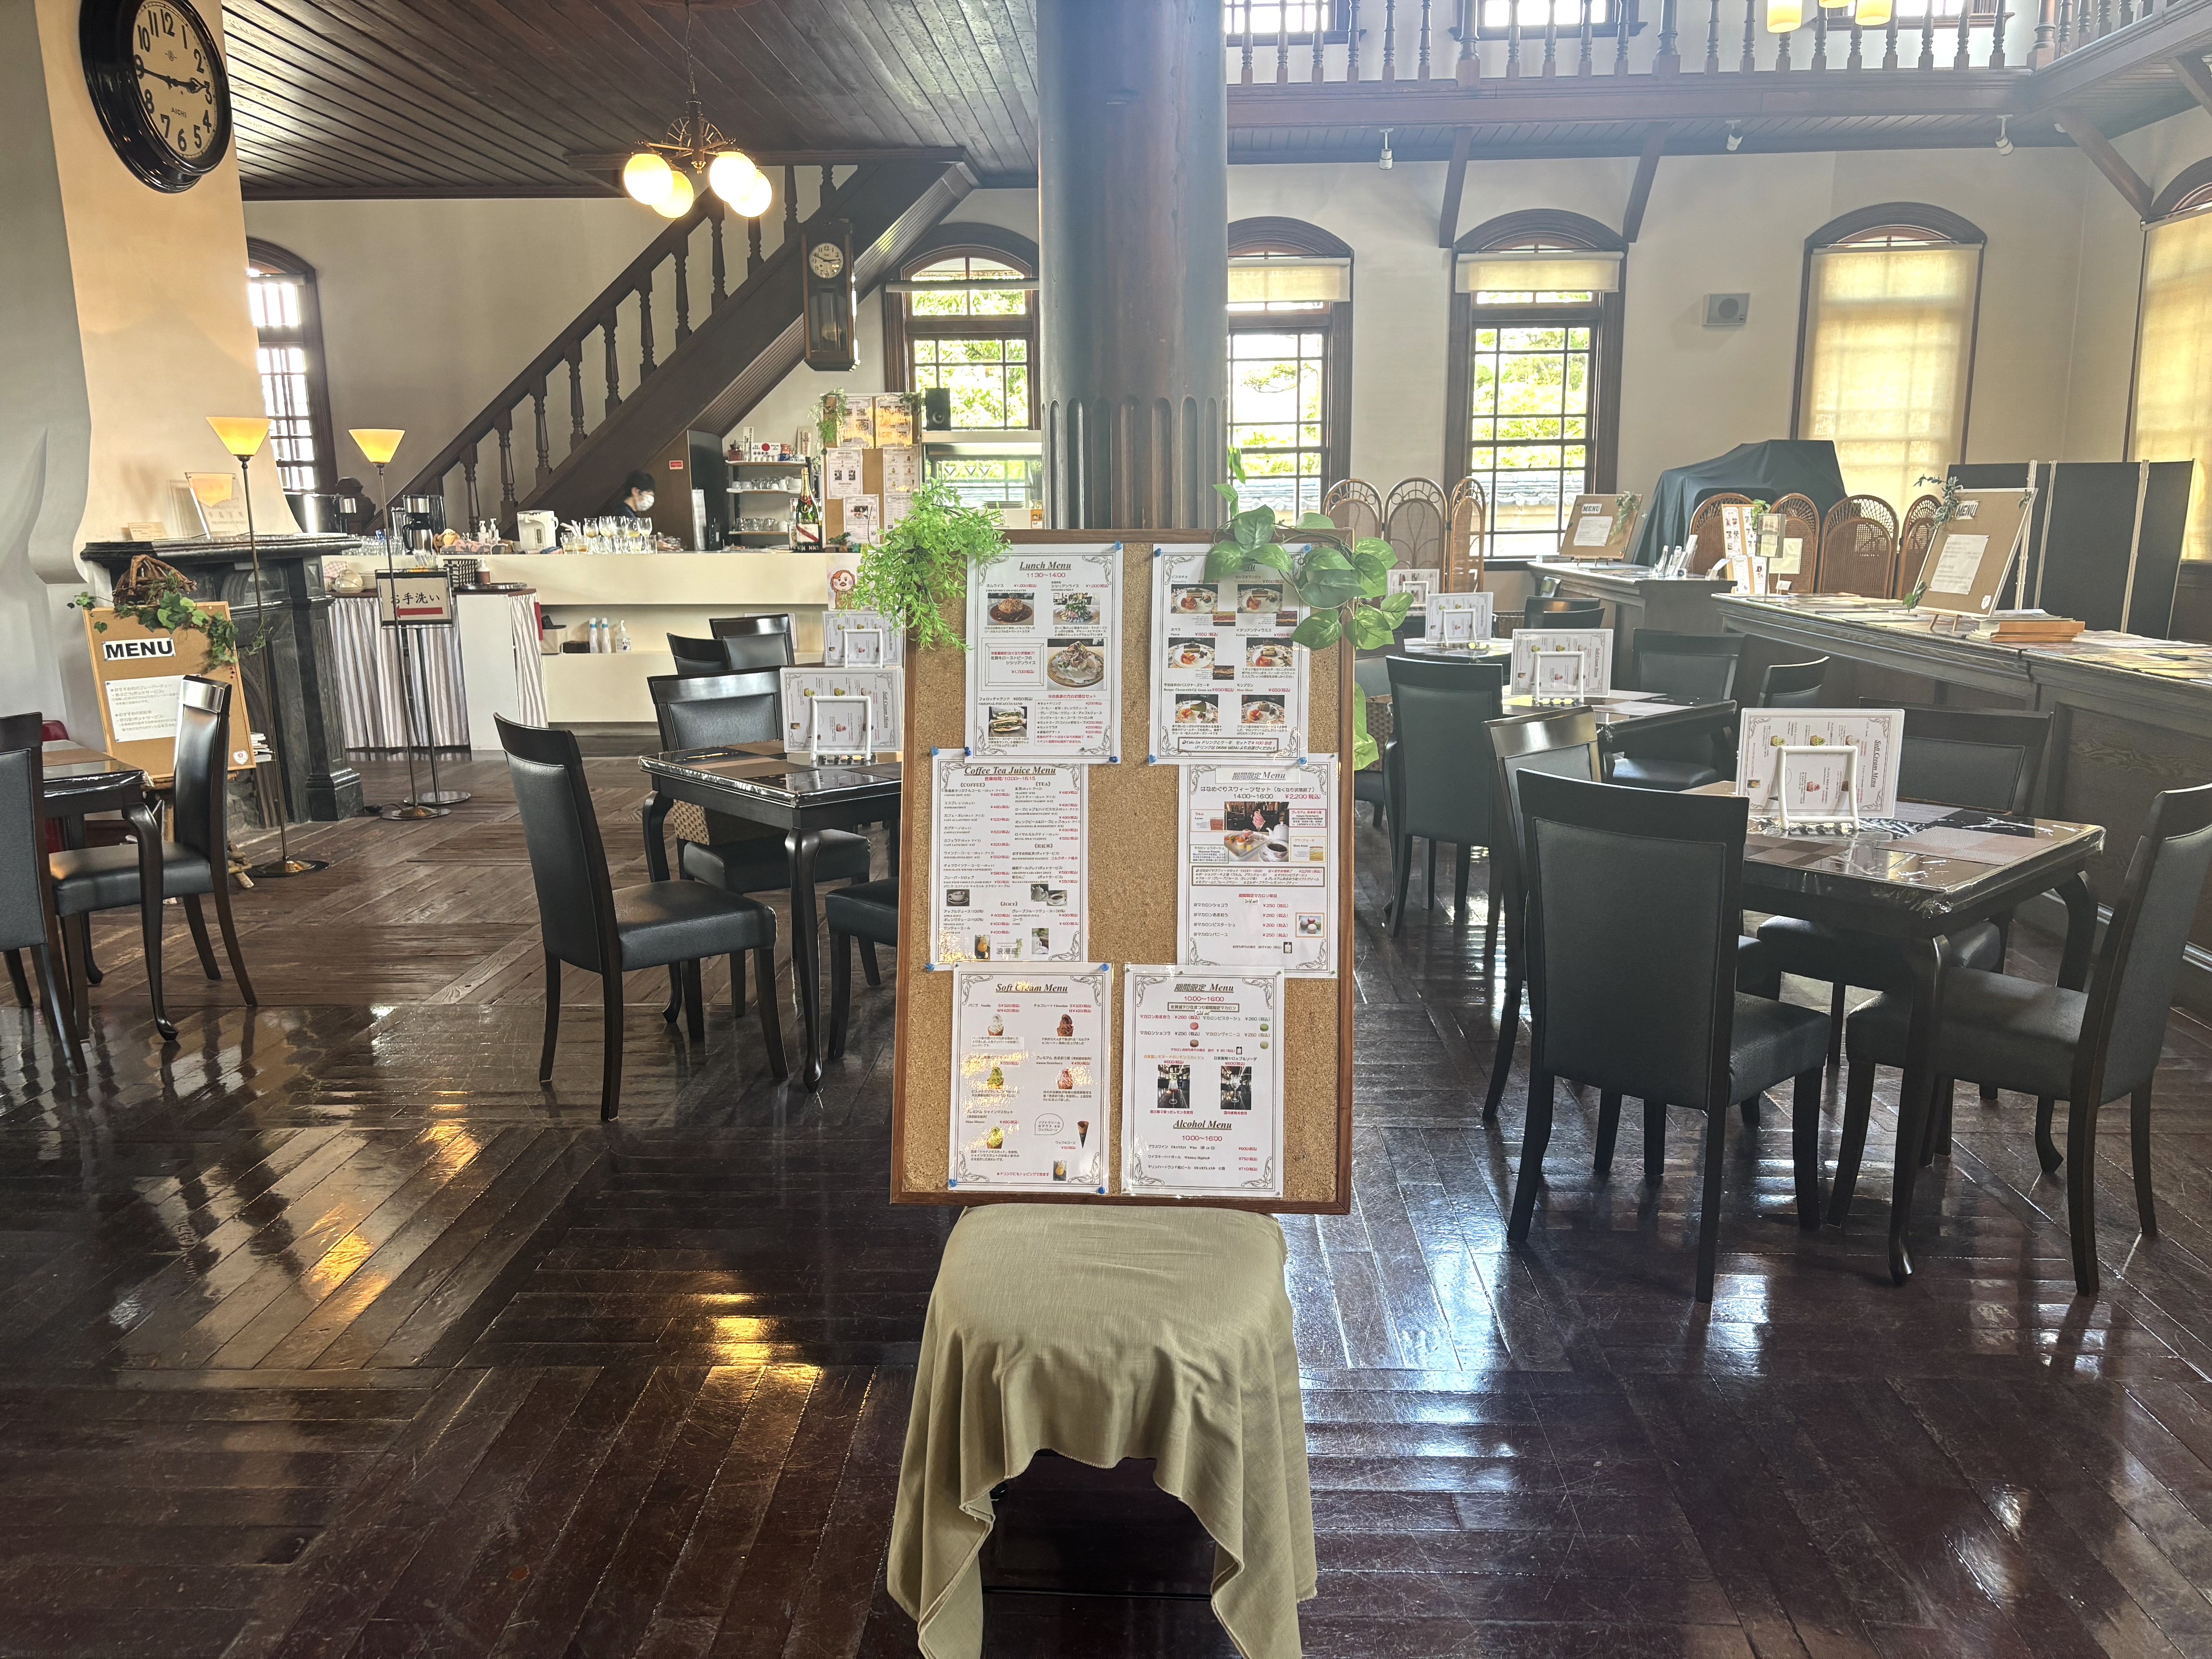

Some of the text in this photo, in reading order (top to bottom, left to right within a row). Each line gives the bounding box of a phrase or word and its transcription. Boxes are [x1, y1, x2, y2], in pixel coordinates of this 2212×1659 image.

[148, 10, 159, 37] 11
[161, 9, 175, 37] 12
[137, 25, 150, 52] 10
[182, 25, 187, 49] 1
[134, 54, 144, 79] 9
[194, 49, 204, 74] 2
[145, 89, 155, 114] 8
[204, 81, 212, 105] 3
[171, 107, 187, 118] AICHI
[203, 110, 211, 133] 4
[160, 114, 170, 138] 7
[194, 125, 202, 149] 5
[178, 129, 187, 151] 6
[1956, 503, 1977, 517] MENU
[1019, 562, 1071, 570] Lunch Menu
[106, 641, 172, 658] MENU
[996, 983, 1013, 992] Soft
[1044, 983, 1068, 992] Menu
[1175, 983, 1234, 991] 期間限定 Menu
[1173, 1120, 1232, 1128] Alcohol Menu
